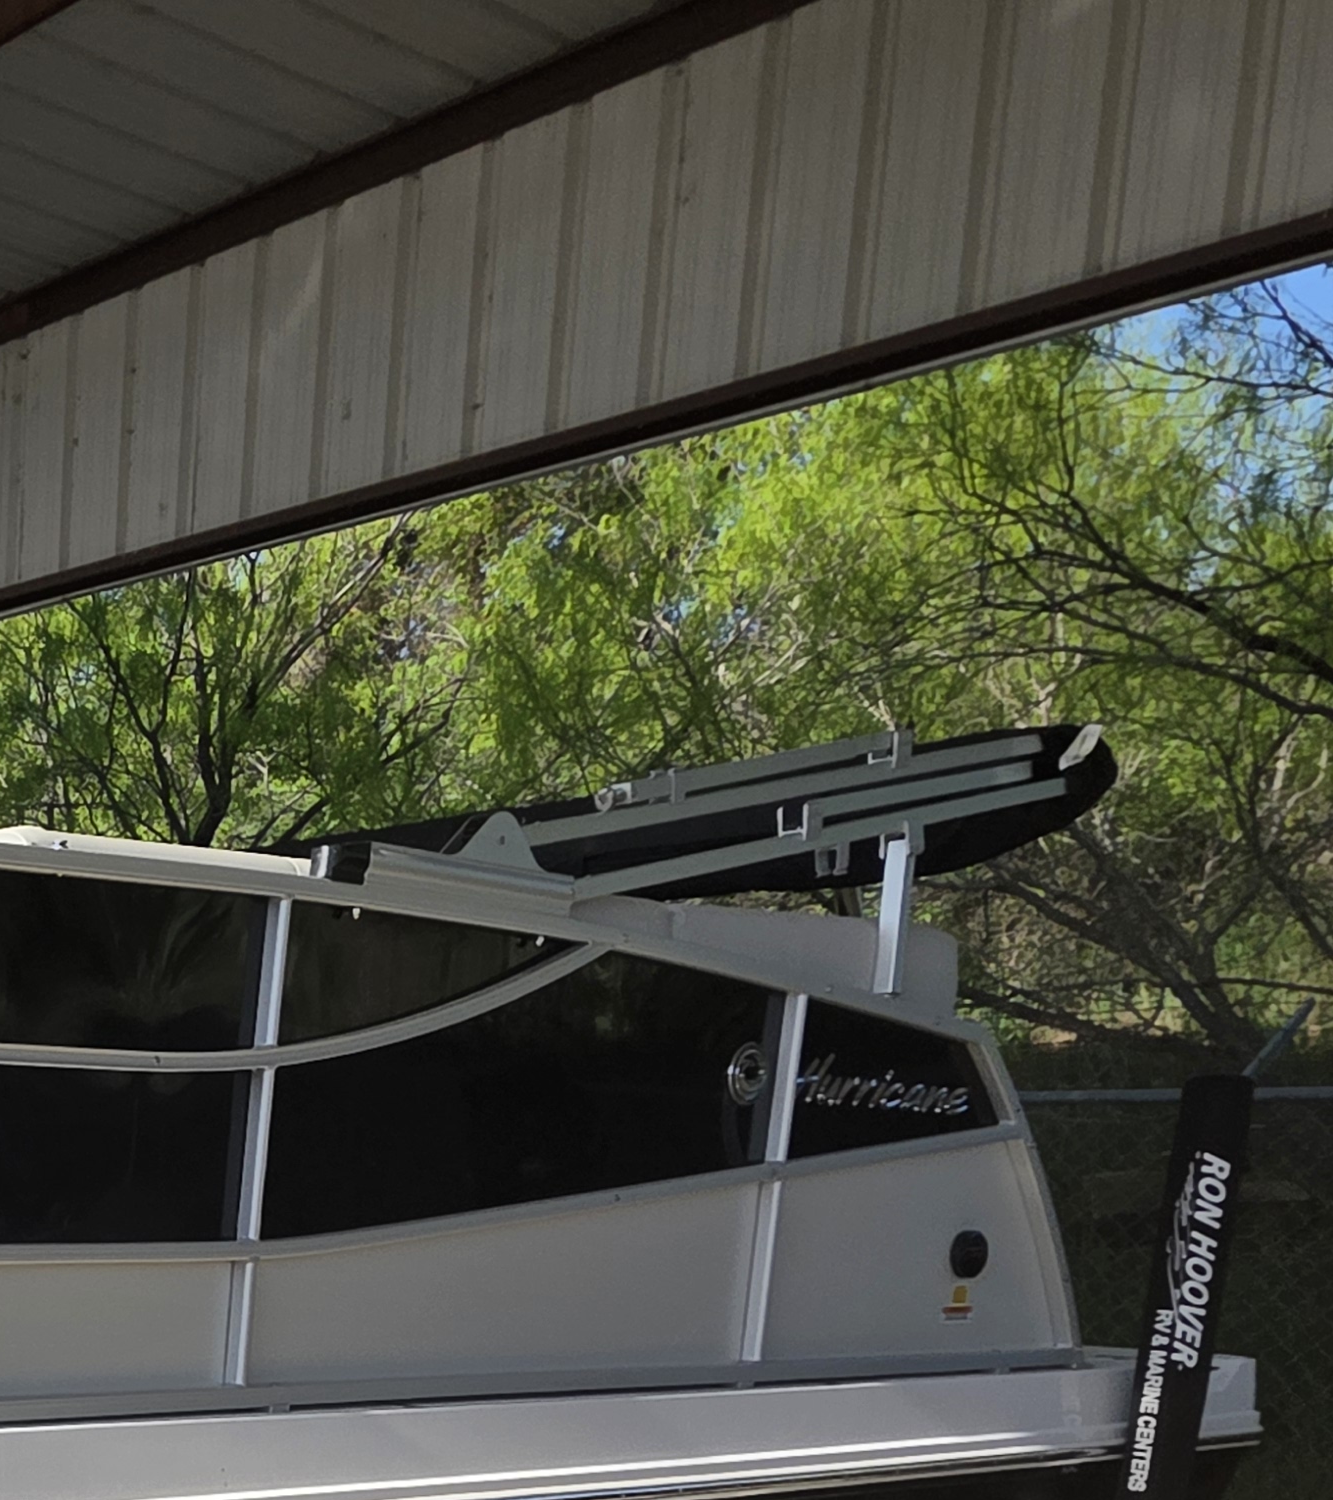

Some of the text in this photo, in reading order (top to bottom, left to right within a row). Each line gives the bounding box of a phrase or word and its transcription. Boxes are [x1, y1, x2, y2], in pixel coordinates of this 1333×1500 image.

[795, 1052, 970, 1116] Hurricane
[1170, 1152, 1231, 1369] RON HOOVER
[1127, 1309, 1174, 1492] RV & MARINE CENTERS
